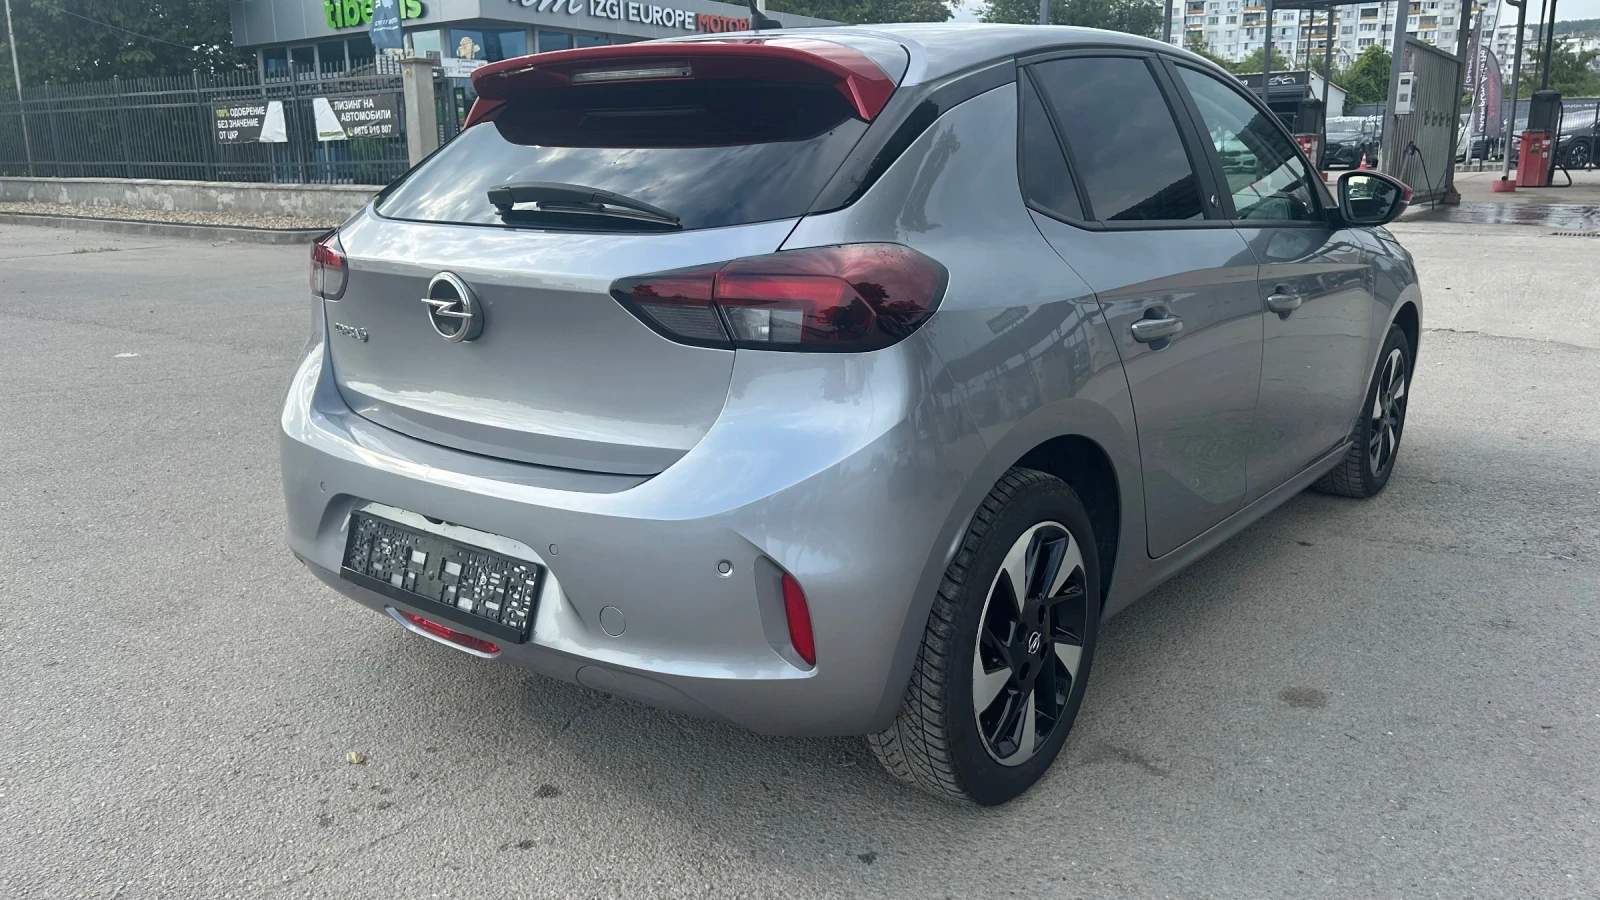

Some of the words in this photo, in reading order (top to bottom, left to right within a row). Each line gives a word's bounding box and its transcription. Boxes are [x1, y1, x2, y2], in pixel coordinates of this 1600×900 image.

[590, 0, 624, 21] IZGI
[628, 6, 696, 30] EUROPE
[334, 100, 362, 111] ЛИЗИНГ
[363, 98, 375, 109] НА
[229, 106, 266, 118] ОДОБРЕНИЕ
[341, 109, 392, 122] АВТОМОБИЛИ
[217, 120, 229, 129] БЕЗ
[229, 118, 260, 128] ЗНАЧЕНИЕ
[219, 131, 227, 139] ОТ
[227, 130, 239, 140] ЦКР
